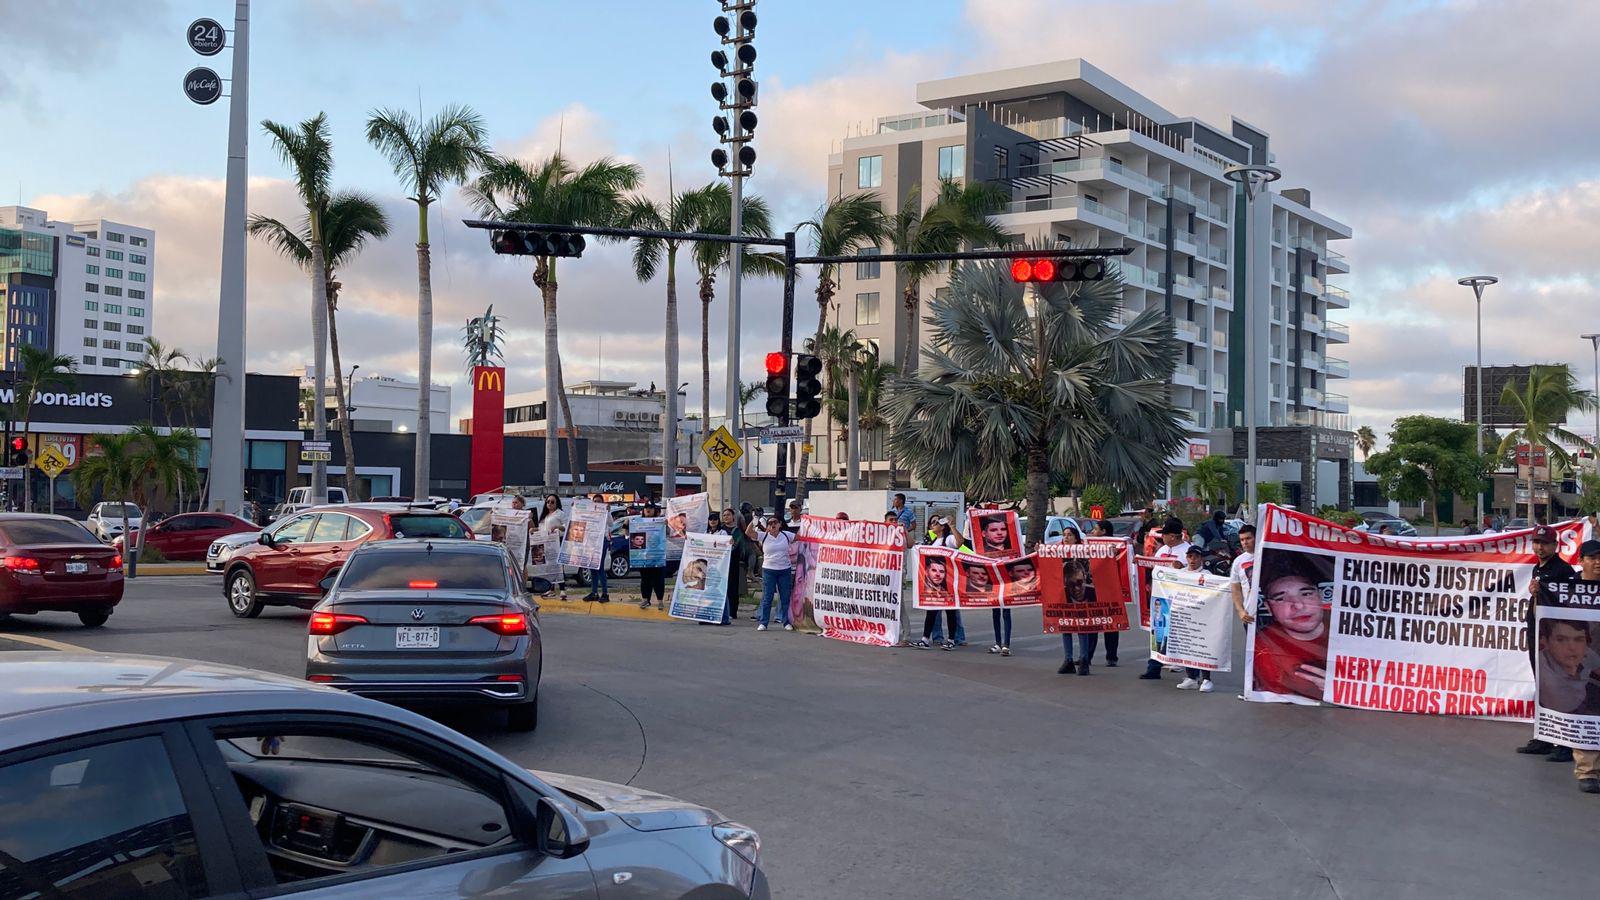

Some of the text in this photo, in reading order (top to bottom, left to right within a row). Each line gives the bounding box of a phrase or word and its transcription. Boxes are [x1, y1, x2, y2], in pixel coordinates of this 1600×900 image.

[194, 25, 218, 41] 24
[1271, 509, 1303, 537] NO
[854, 551, 902, 571] JUSTICIA!
[1038, 543, 1115, 559] DESAPARECIDO
[854, 571, 890, 587] BUSCANDO
[1343, 558, 1516, 593] EXIGIMOS JUSTICIA
[855, 588, 863, 600] DE
[864, 589, 881, 602] ESTE
[1548, 582, 1600, 595] SE BU
[1340, 585, 1361, 609] LO
[1366, 587, 1464, 619] QUEREMOS
[1468, 596, 1491, 620] DE
[1059, 616, 1113, 626] 667 157 1930
[1338, 611, 1529, 651] HASTA ENCONTRARLO
[1335, 655, 1487, 694] NERY ALEJANDRO
[1333, 680, 1441, 715] VILLALOBOS
